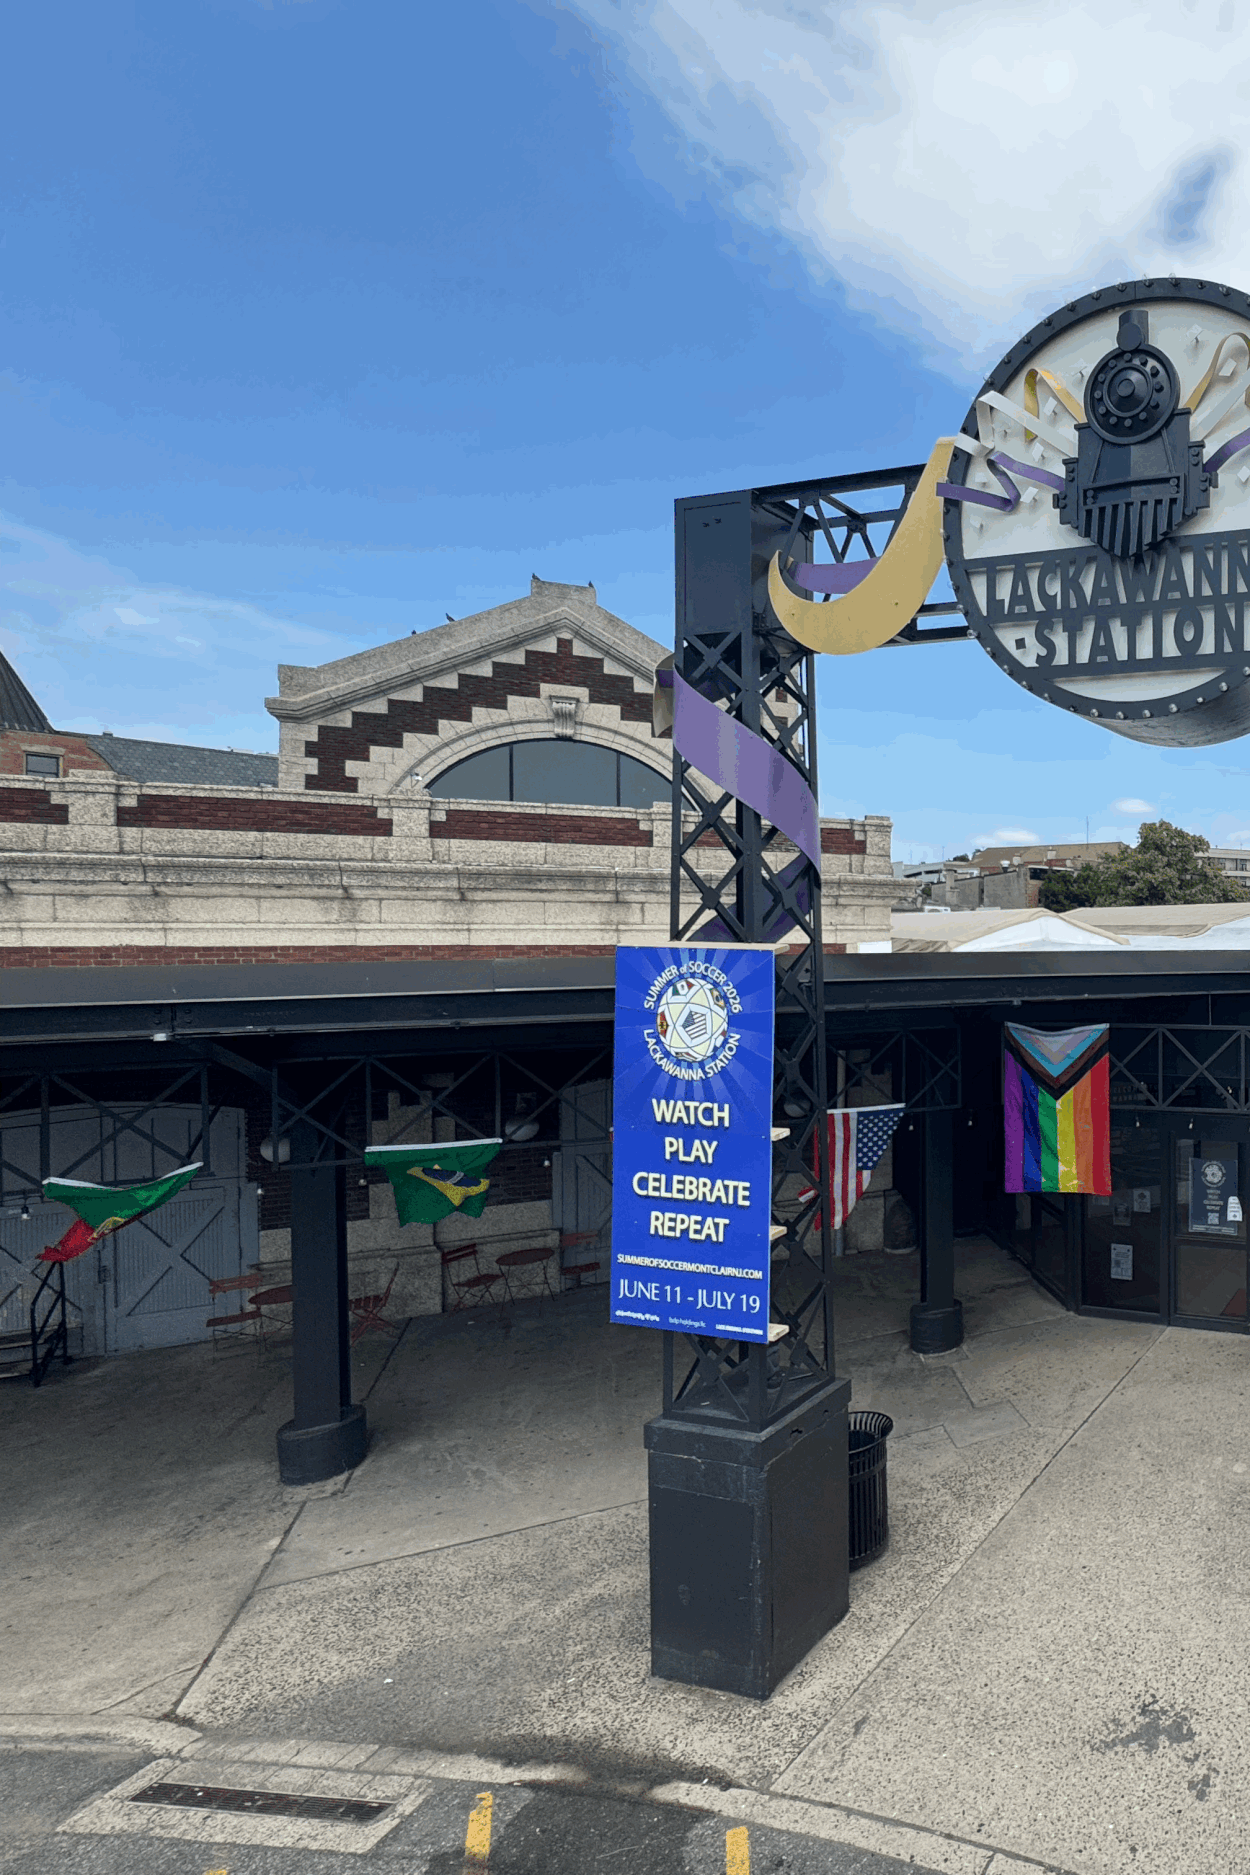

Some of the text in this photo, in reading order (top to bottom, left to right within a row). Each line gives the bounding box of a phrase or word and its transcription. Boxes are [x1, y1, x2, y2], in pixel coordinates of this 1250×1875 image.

[1034, 602, 1245, 668] STATION
[643, 960, 743, 1014] SUMMER of SOCCER 2026
[643, 1028, 742, 1081] LACKAWANNA STATION
[651, 1098, 730, 1127] WATCH
[664, 1136, 718, 1164] PLAY
[632, 1171, 751, 1206] CELEBRATE
[649, 1211, 730, 1242] REPEAT
[617, 1253, 763, 1280] SUMMEROFSOCCERMONTCLAIRNJ.COM
[618, 1278, 660, 1301] JUNE
[664, 1285, 681, 1304] 11
[696, 1288, 735, 1310] JULY
[740, 1294, 760, 1314] 19
